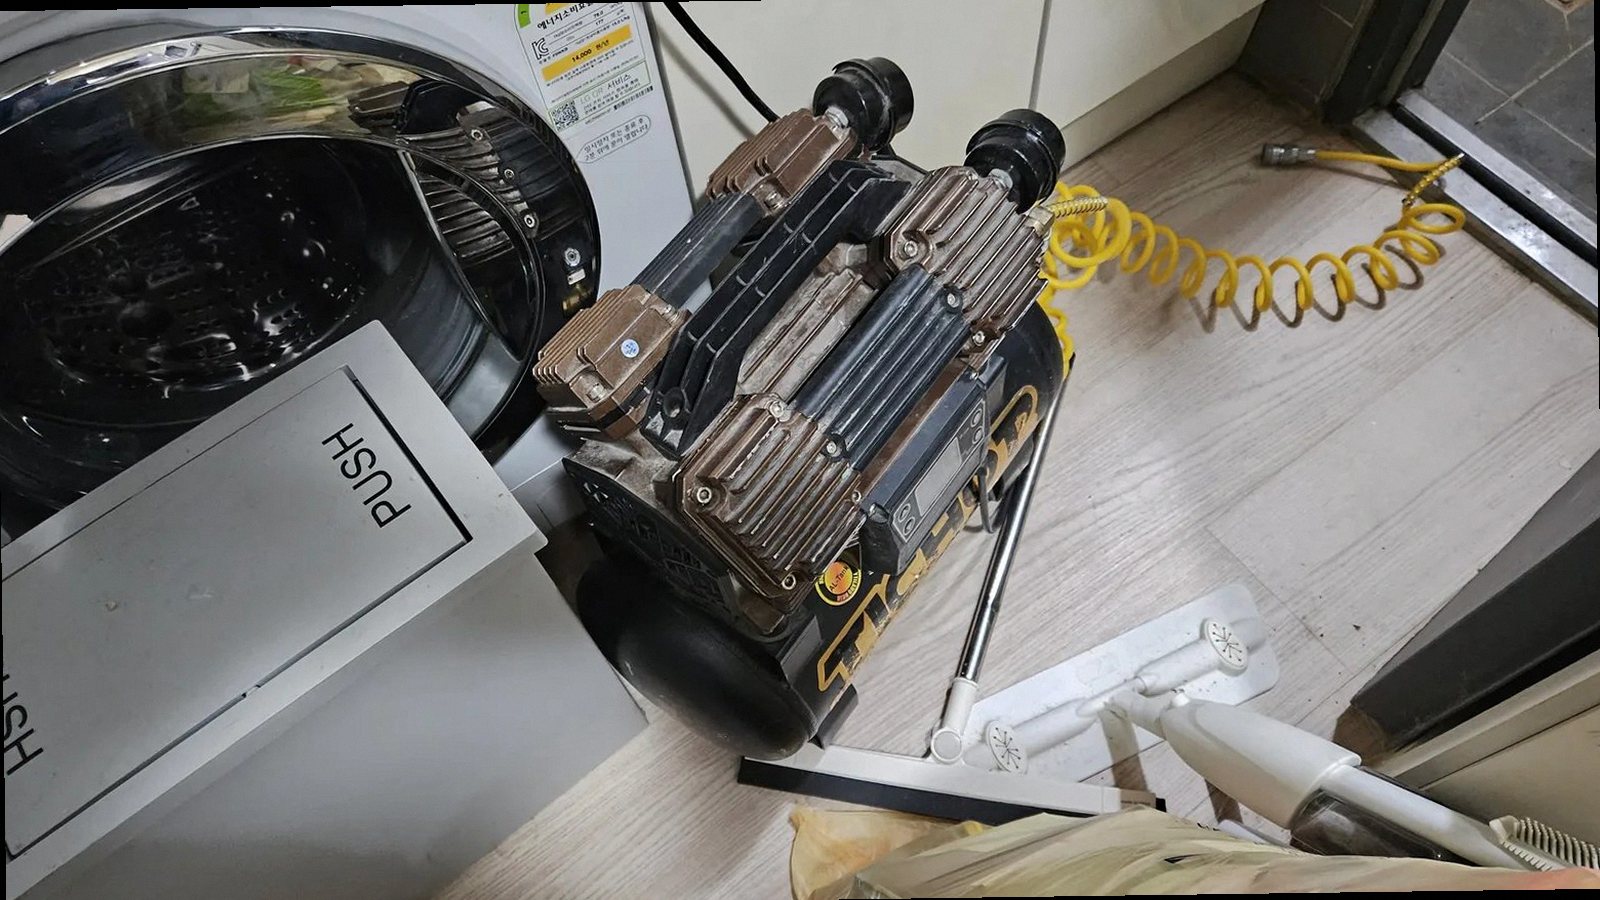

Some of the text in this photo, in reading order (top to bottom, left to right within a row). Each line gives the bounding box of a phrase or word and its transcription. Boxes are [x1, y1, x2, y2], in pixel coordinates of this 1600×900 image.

[572, 48, 592, 62] 14,000
[607, 73, 632, 89] 서비스
[321, 422, 412, 528] PUSH
[829, 565, 849, 591] AL-Tank
[3, 673, 44, 776] SH
